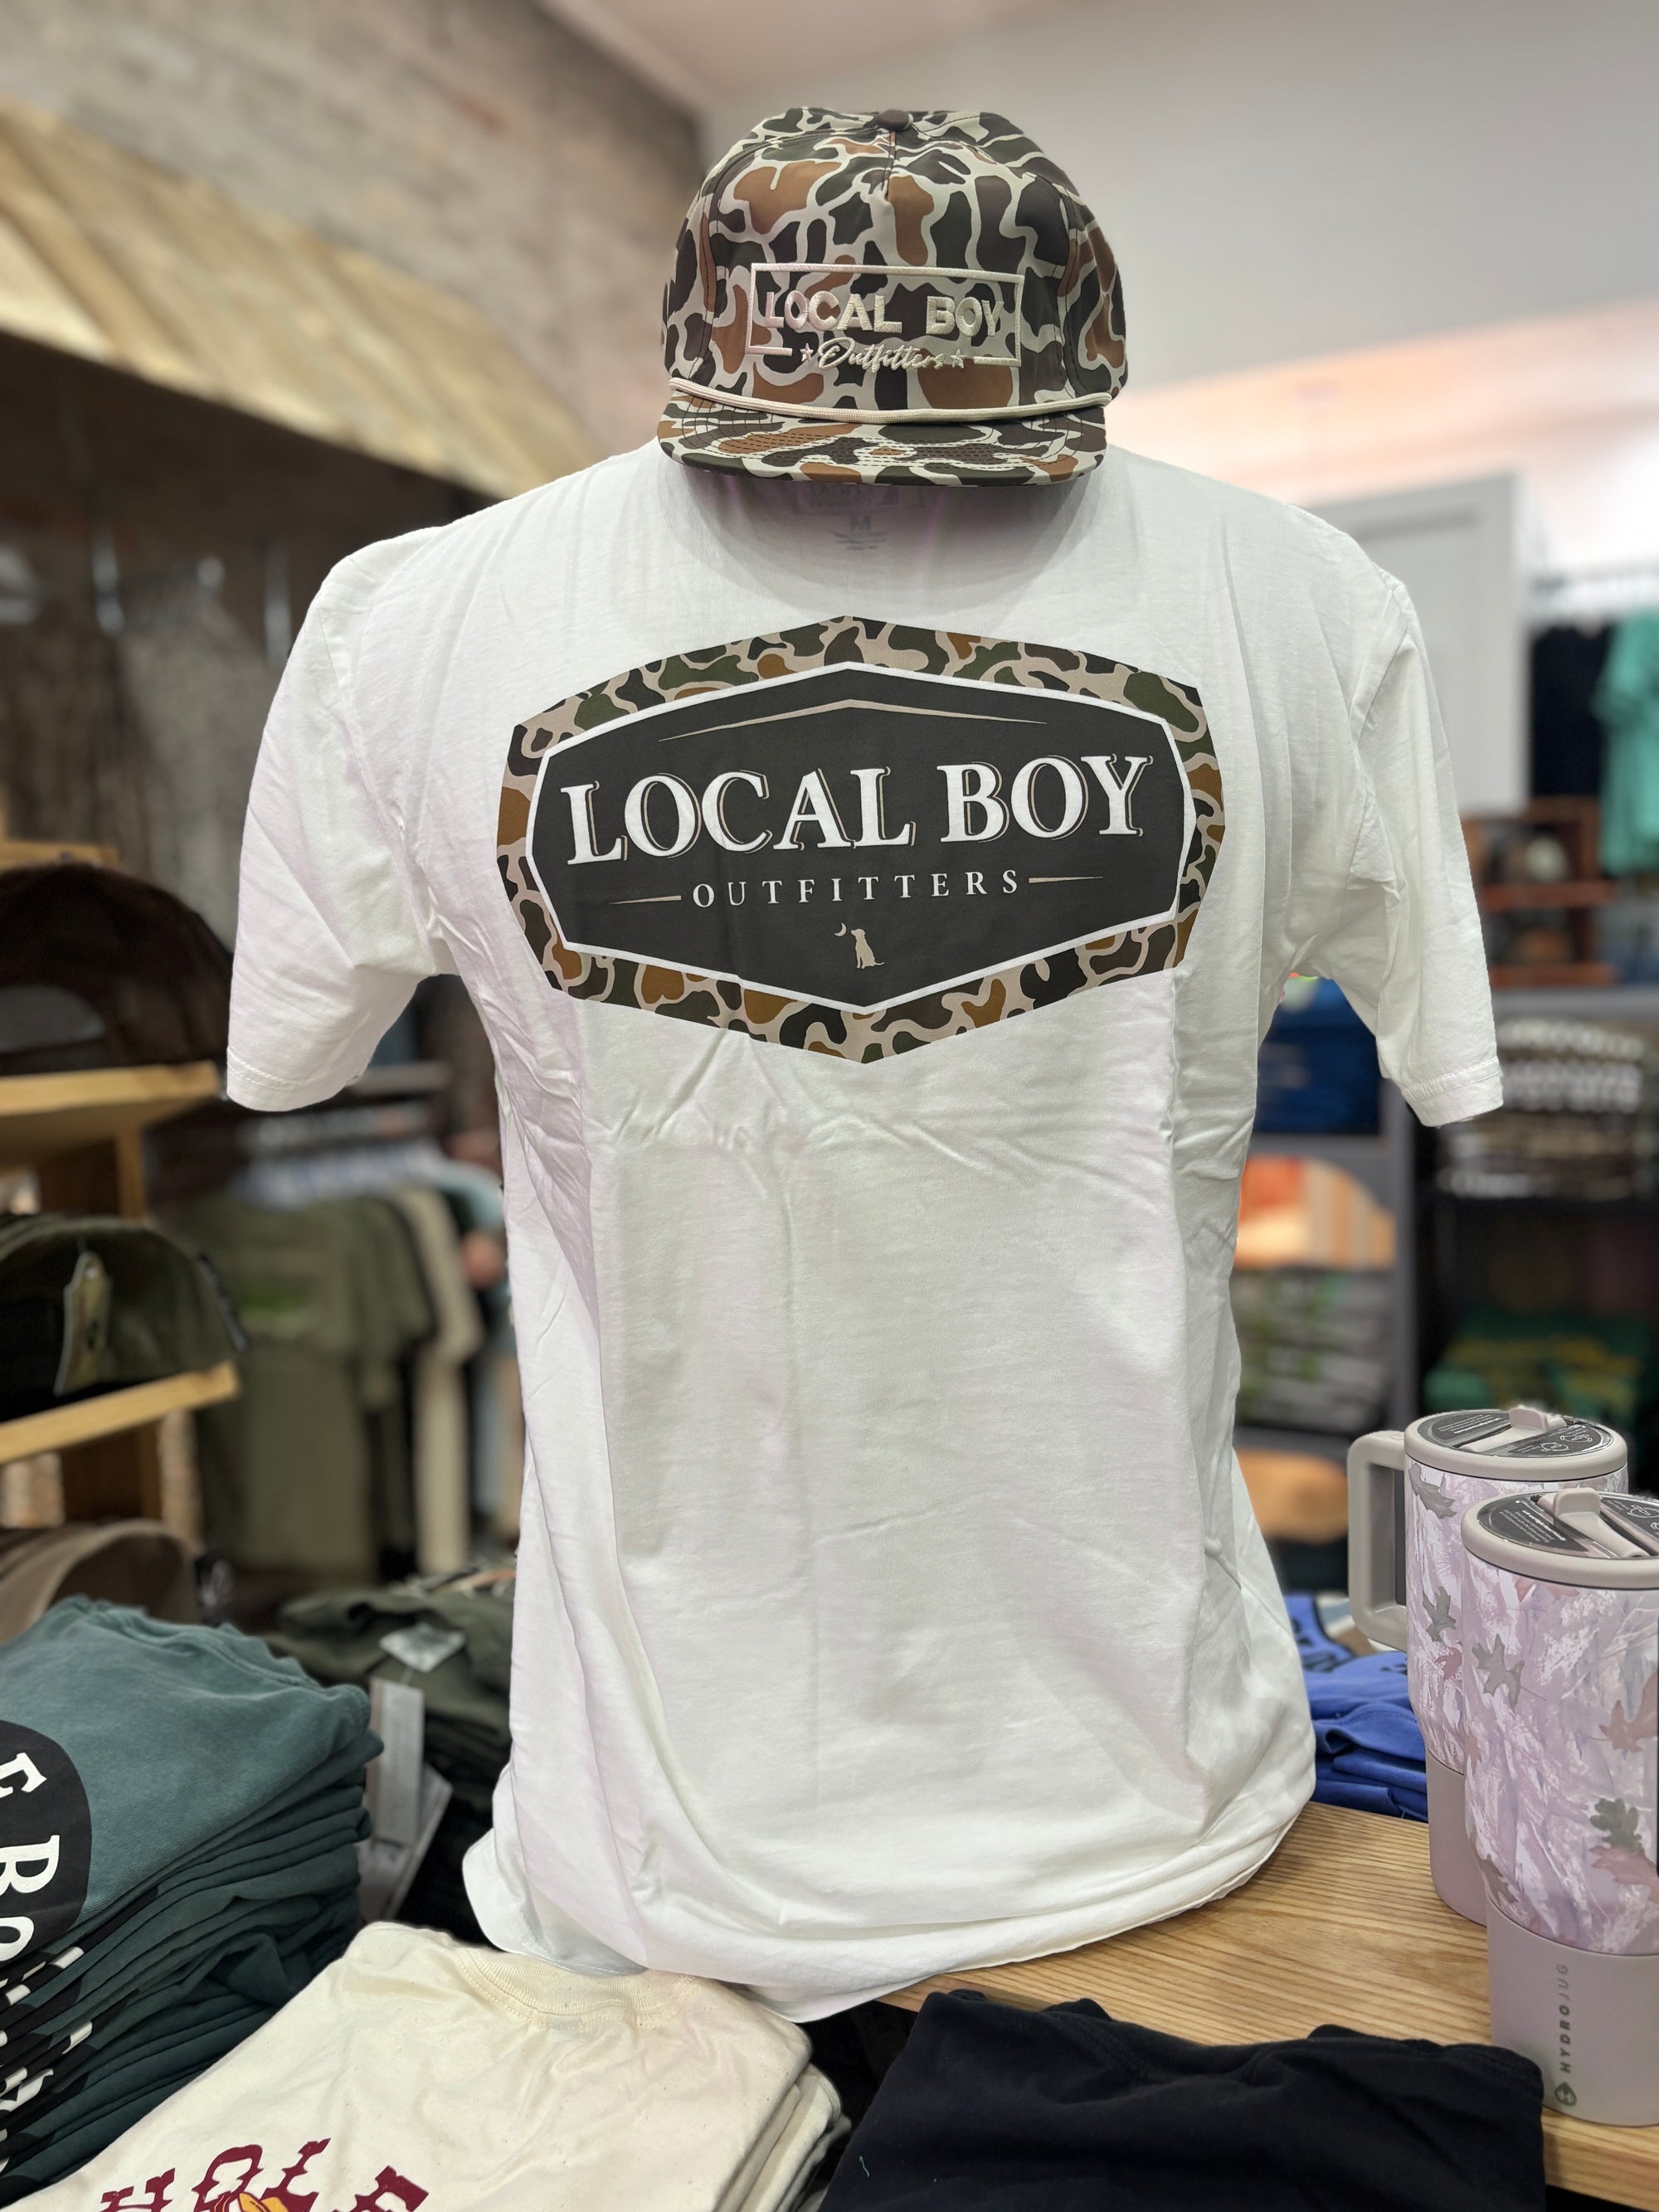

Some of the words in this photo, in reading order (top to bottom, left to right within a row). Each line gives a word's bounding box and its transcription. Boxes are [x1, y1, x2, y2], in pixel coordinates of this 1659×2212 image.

[765, 290, 902, 333] LOCAL
[926, 295, 1005, 337] BOY
[818, 337, 945, 372] Outfitters
[561, 767, 916, 865] LOCAL
[937, 753, 1154, 843] BOY
[693, 870, 1018, 908] OUTFITTERS
[1556, 1963, 1572, 2074] HYDROJUG
